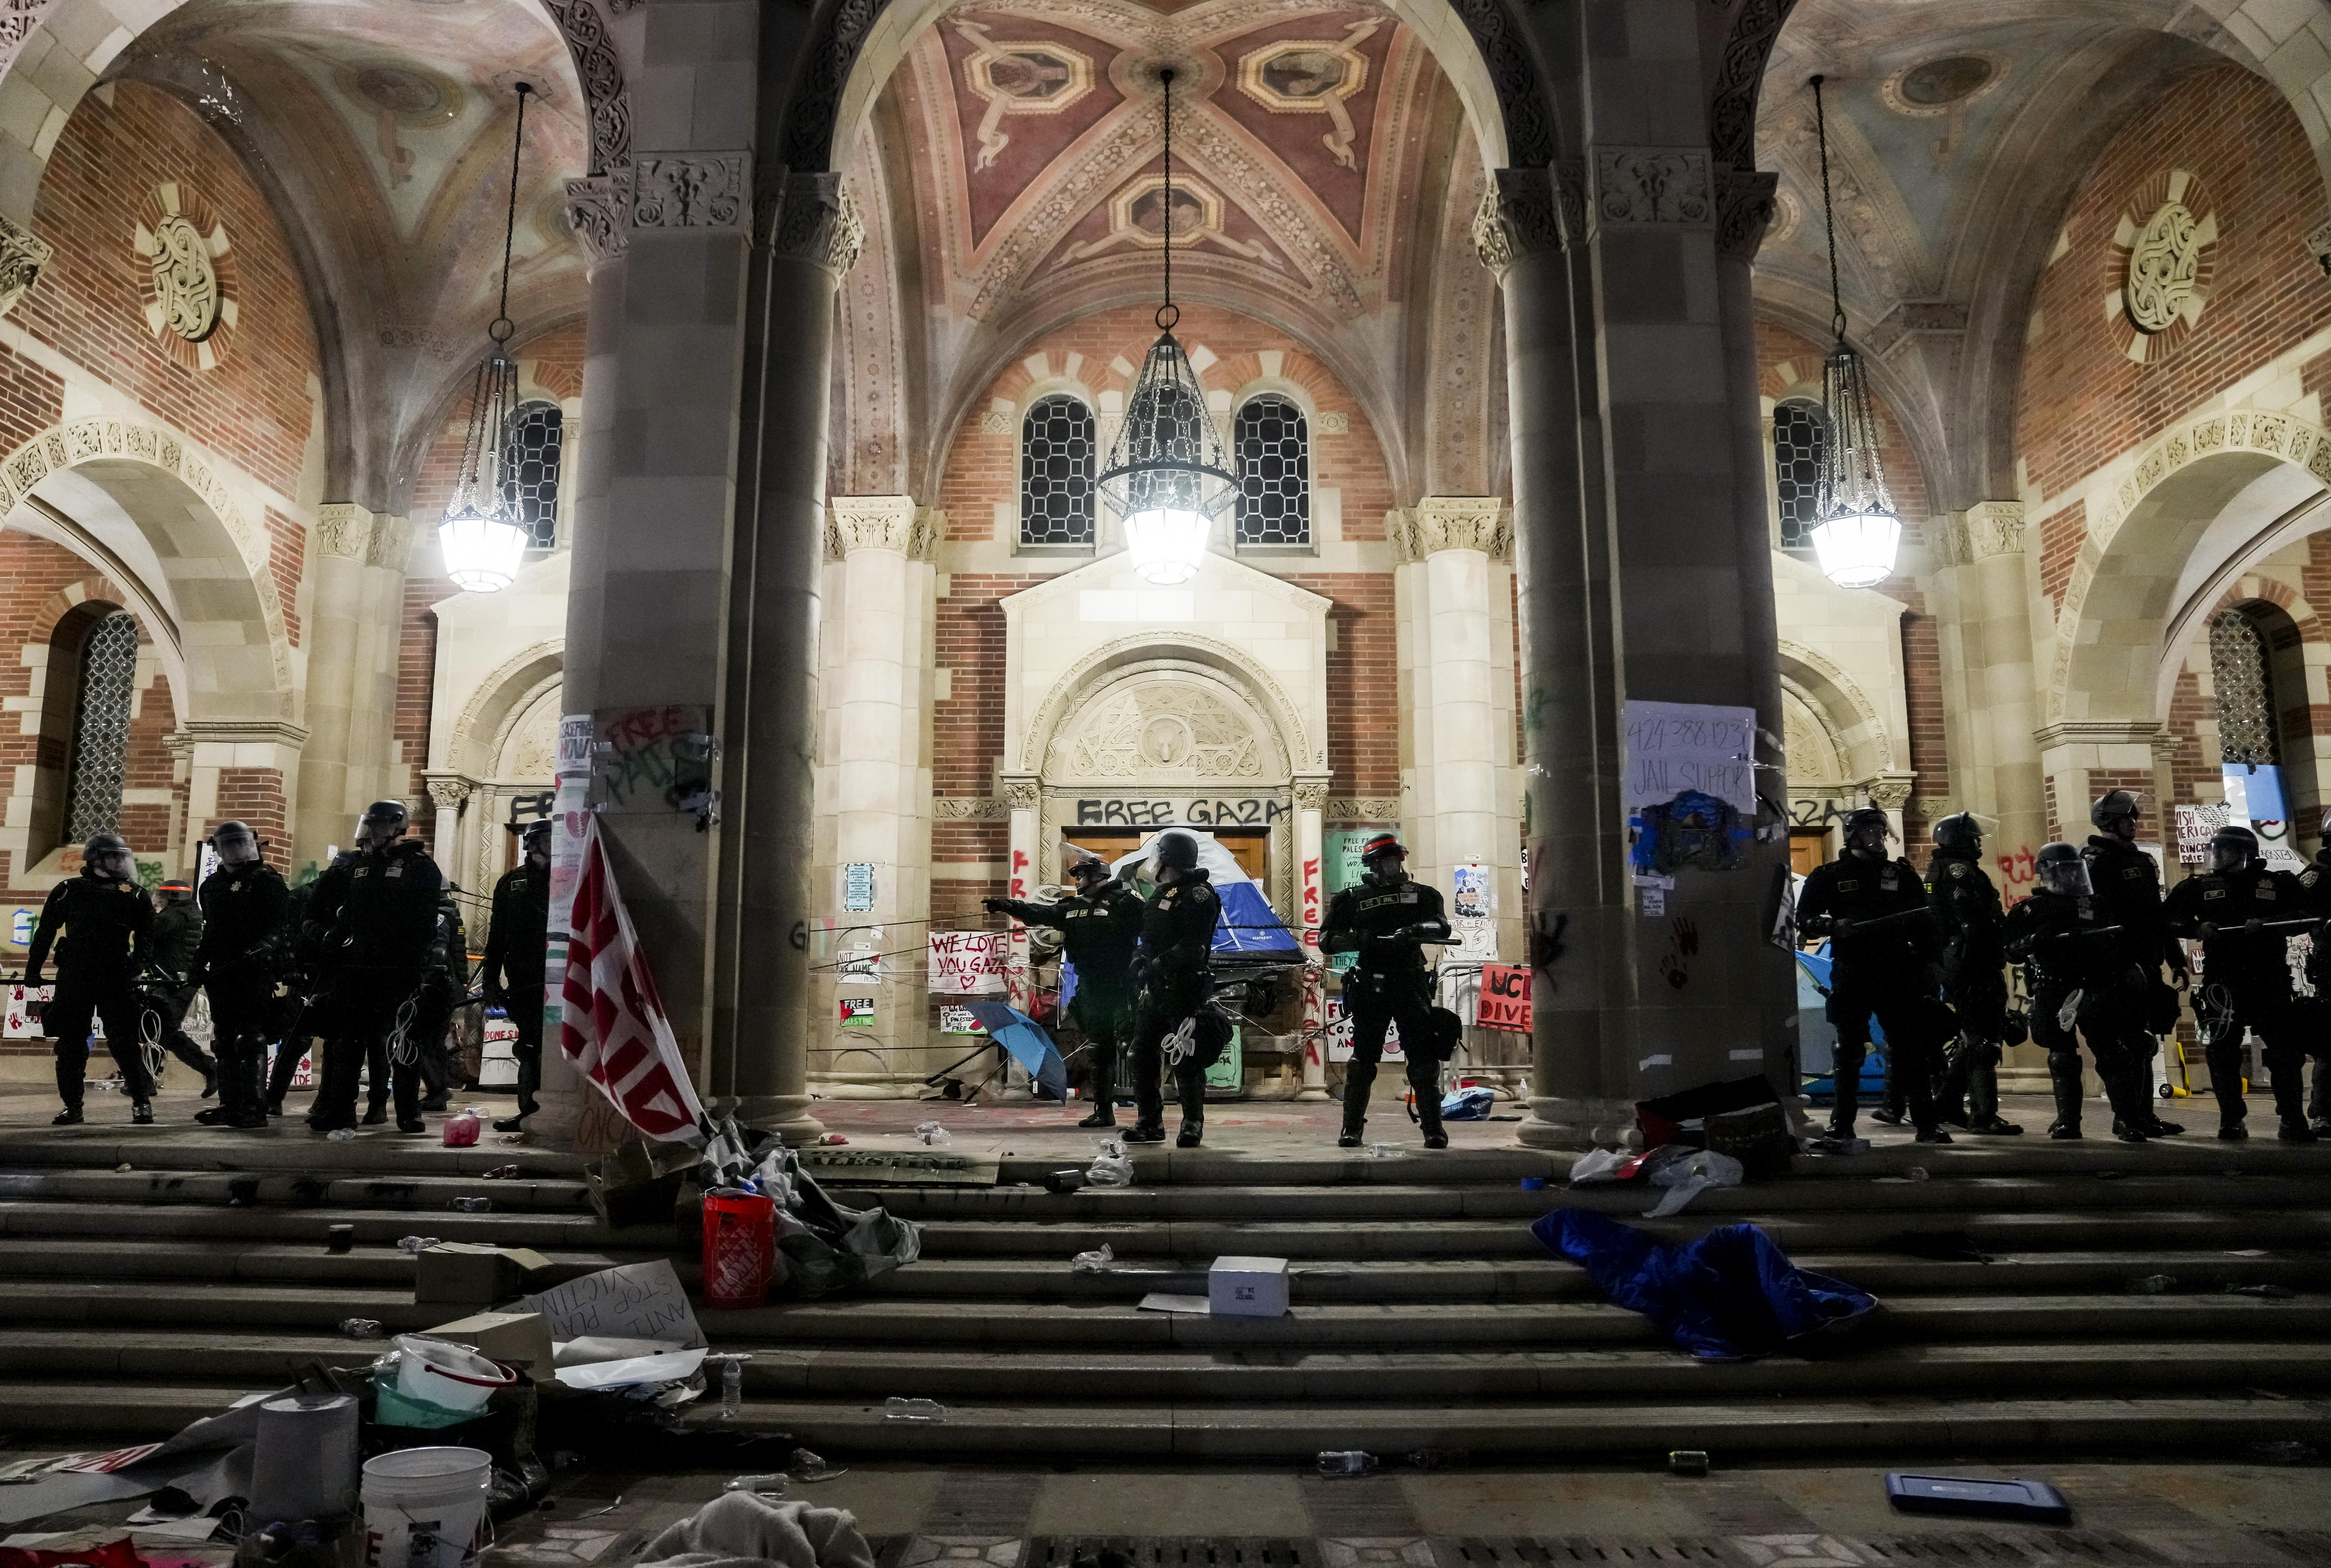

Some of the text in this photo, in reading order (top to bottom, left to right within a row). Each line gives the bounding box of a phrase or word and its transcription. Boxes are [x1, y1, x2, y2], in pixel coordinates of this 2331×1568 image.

[1077, 800, 1174, 825] FREE
[1475, 920, 1496, 928] EXISTIR
[931, 933, 1007, 954] WE LOVE
[840, 952, 854, 963] NOT
[852, 964, 873, 975] NAME
[938, 956, 1007, 979] YOU GAZA
[844, 999, 870, 1009] FREE
[614, 1274, 673, 1314] STOP
